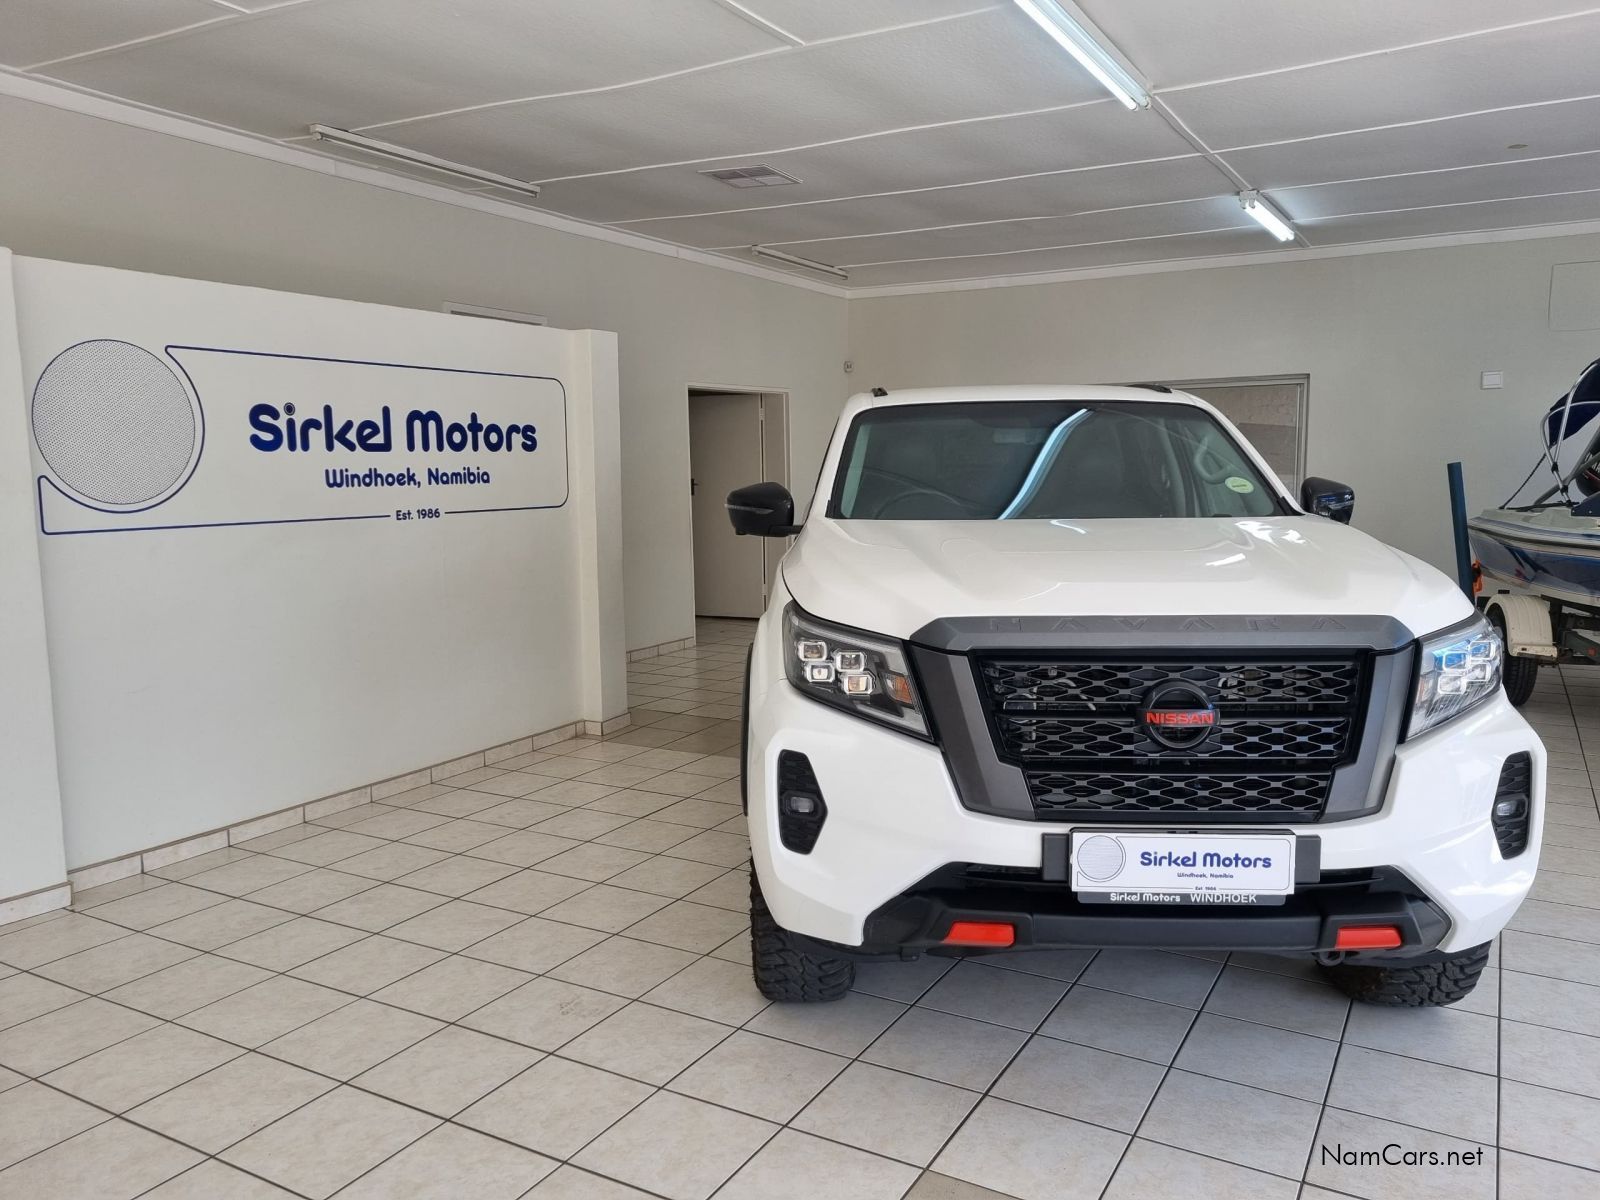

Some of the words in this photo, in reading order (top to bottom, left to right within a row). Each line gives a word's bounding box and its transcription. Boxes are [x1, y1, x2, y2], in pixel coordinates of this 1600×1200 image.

[248, 402, 392, 453] Sirkel
[406, 409, 538, 453] Motors
[324, 467, 421, 489] Windhoek,
[427, 466, 490, 486] Namibia
[395, 509, 414, 521] Est.
[416, 508, 441, 520] 1986
[1146, 711, 1214, 726] NISSAN
[1140, 851, 1197, 868] Sirkel
[1203, 852, 1272, 869] Motors
[1110, 892, 1139, 902] Sirkel
[1143, 893, 1181, 903] Motors
[1190, 893, 1257, 904] WINDHOEK
